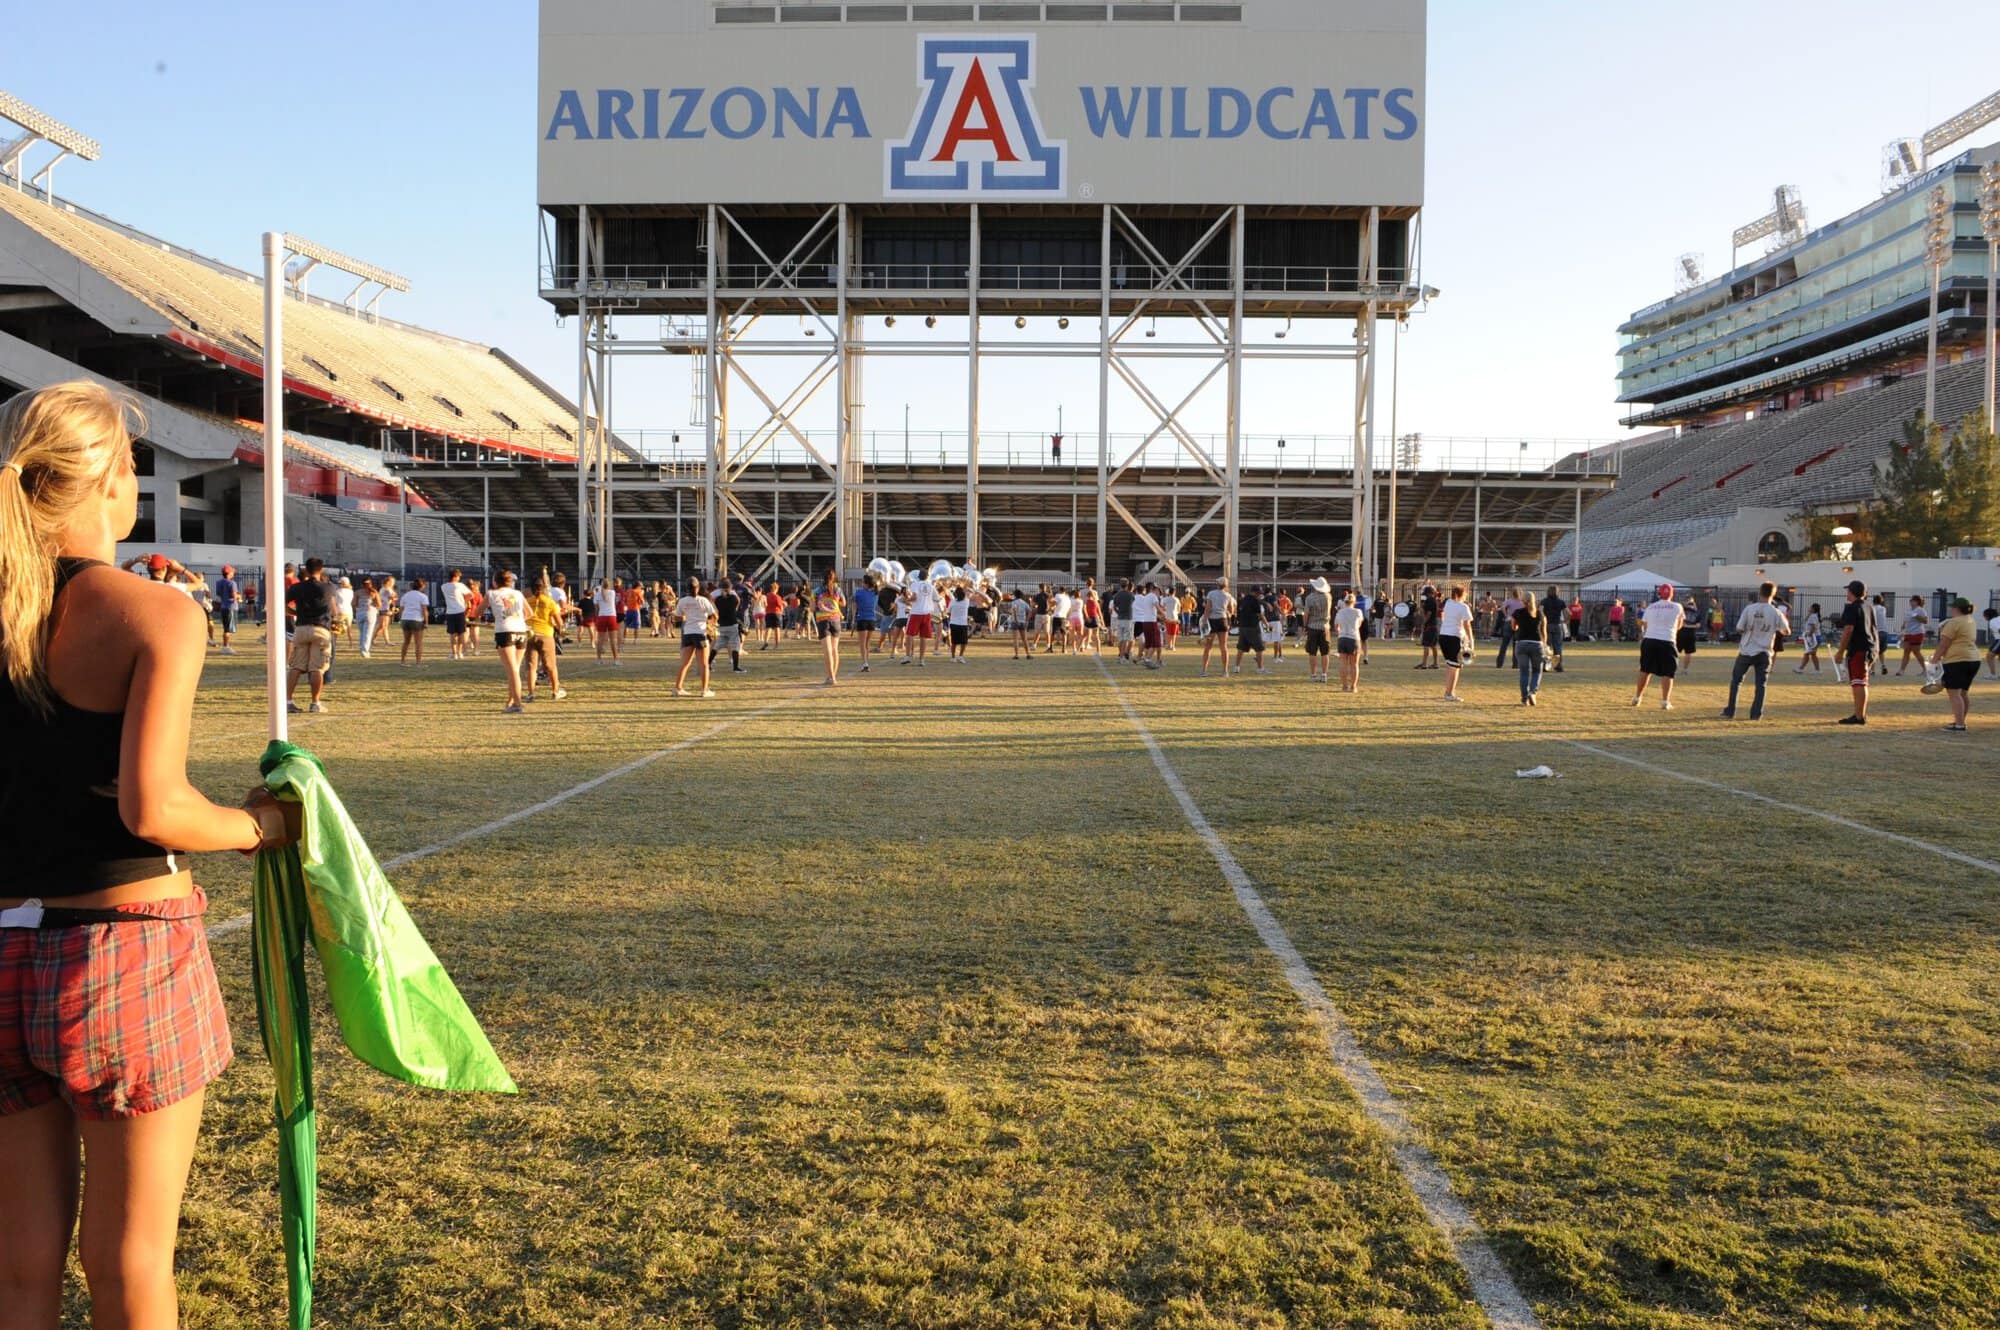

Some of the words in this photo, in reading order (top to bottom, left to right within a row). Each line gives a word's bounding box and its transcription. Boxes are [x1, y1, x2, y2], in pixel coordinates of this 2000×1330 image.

[545, 87, 872, 141] ARIZONA
[885, 34, 1067, 196] A
[1079, 87, 1419, 142] WILDCATS
